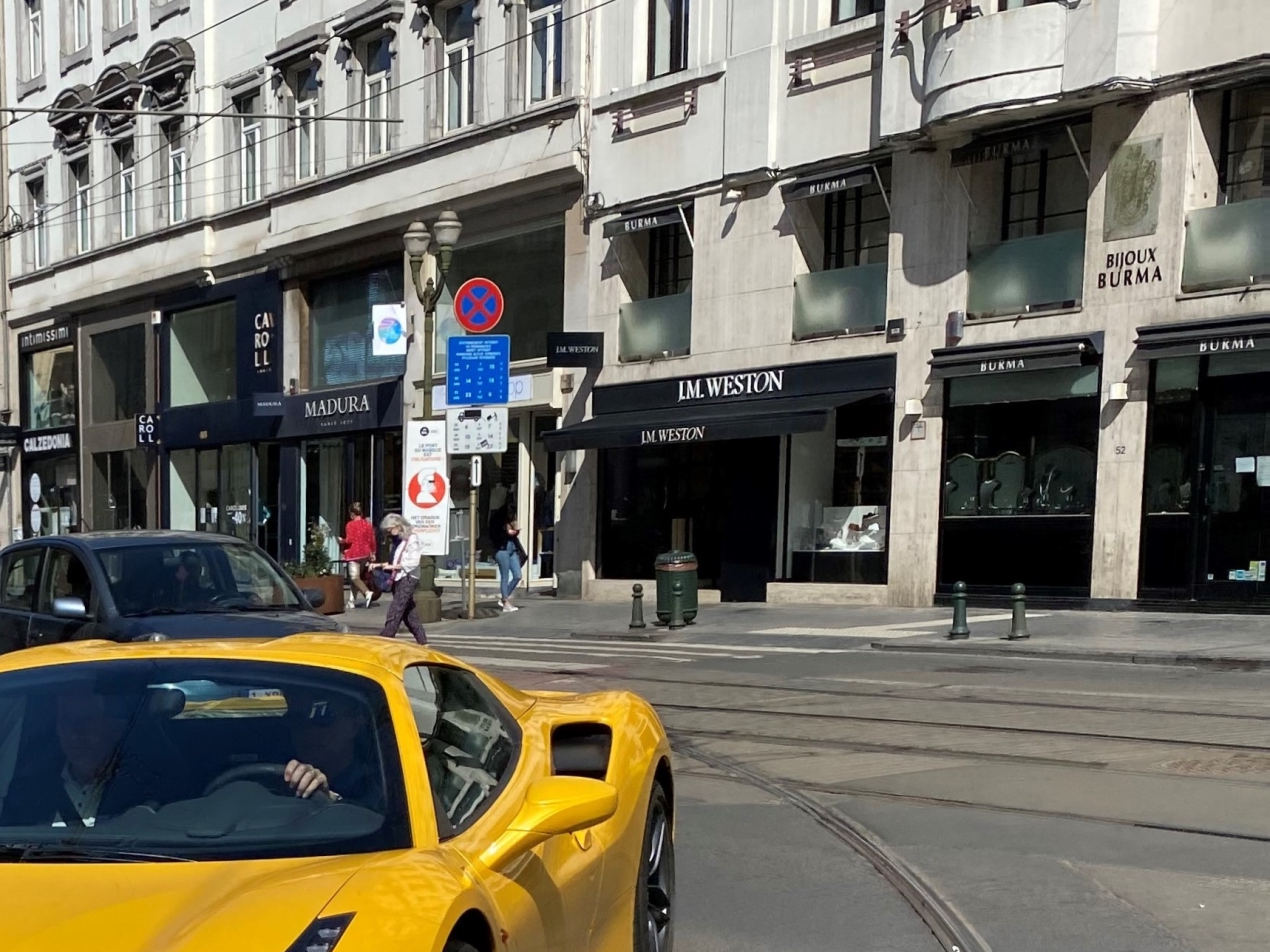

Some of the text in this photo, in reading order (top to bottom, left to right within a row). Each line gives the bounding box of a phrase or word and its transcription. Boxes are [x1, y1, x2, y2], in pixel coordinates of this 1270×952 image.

[809, 178, 847, 194] BURMA
[624, 217, 658, 231] BURMA
[1106, 247, 1158, 269] BIJOUX
[1098, 265, 1162, 289] BURMA
[21, 327, 69, 348] intimissimi
[1199, 337, 1255, 352] BURMA
[568, 345, 599, 353] WESTON
[980, 359, 1025, 372] BURMA
[677, 369, 784, 402] J.M. WESTON
[304, 394, 370, 418] MADURA
[24, 433, 71, 453] CALZEDONIA
[641, 426, 706, 445] J.M. WESTON
[1115, 446, 1126, 454] 52
